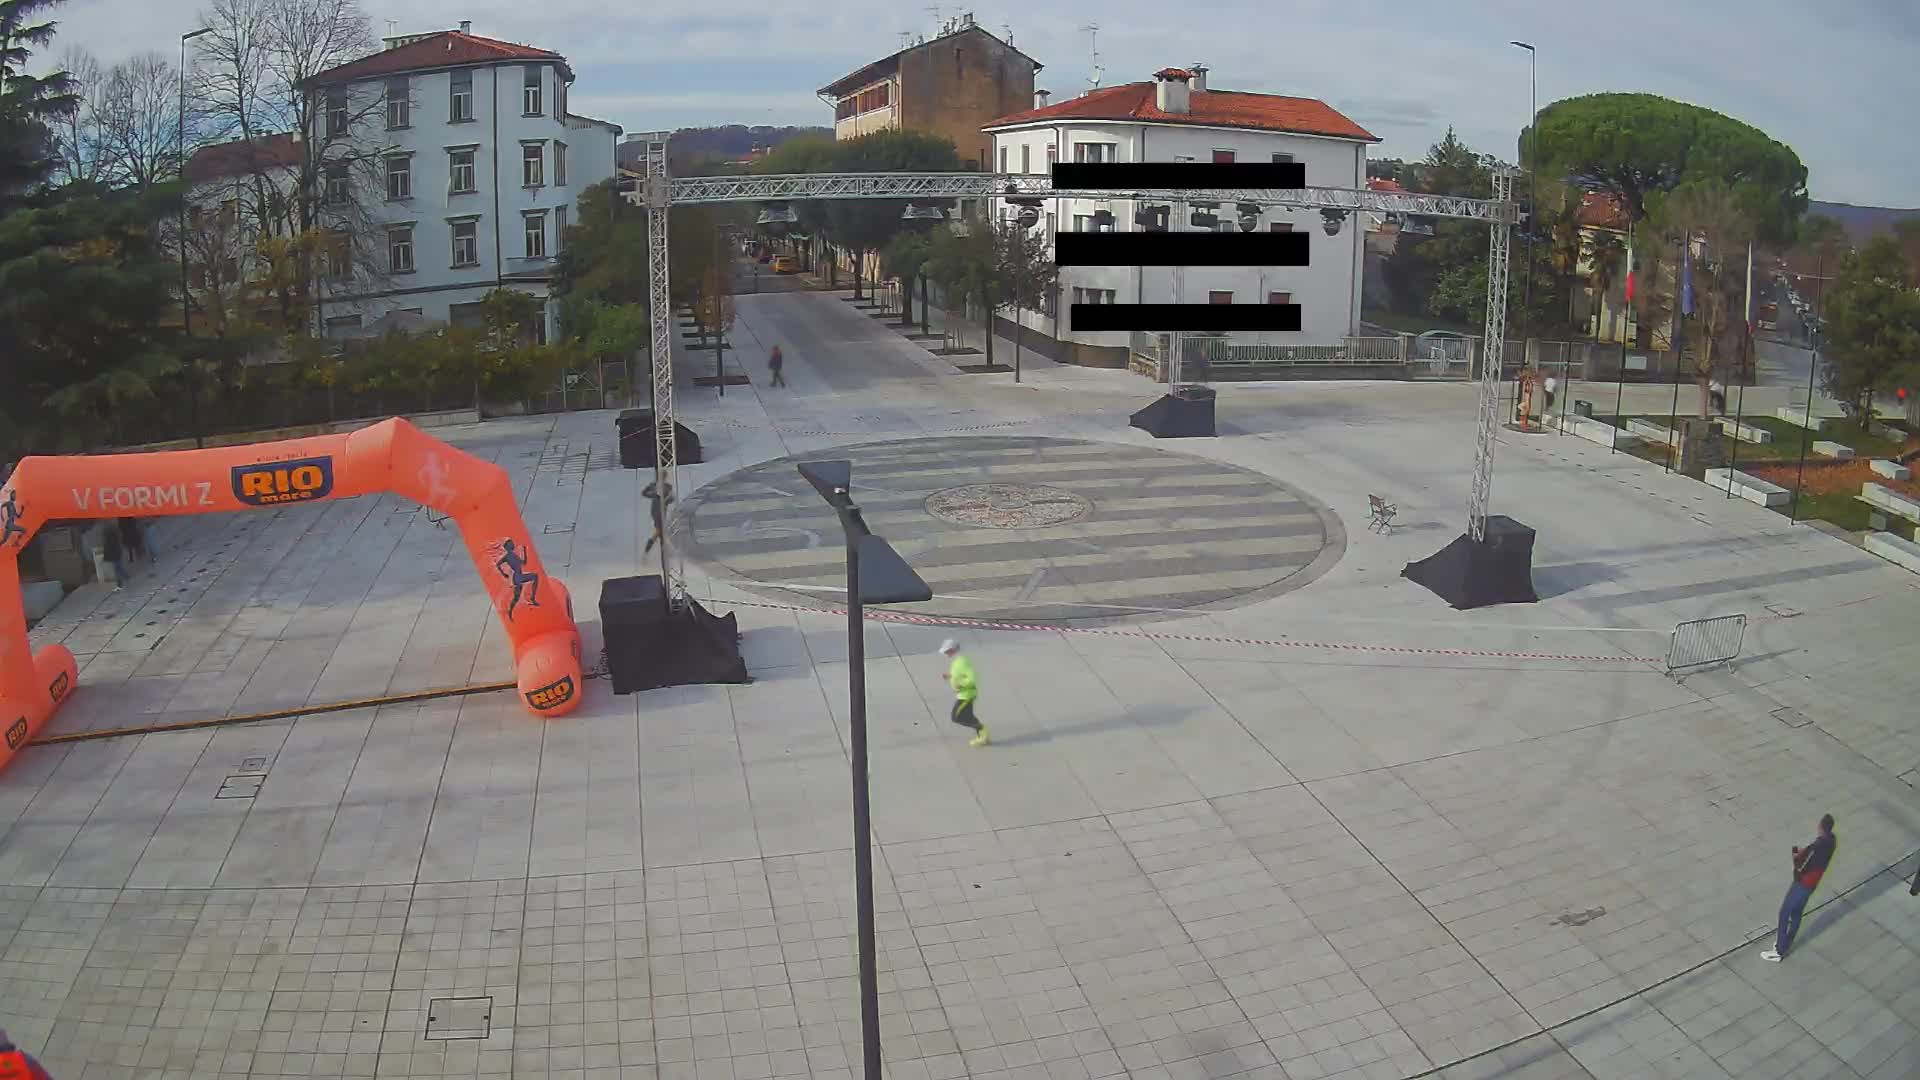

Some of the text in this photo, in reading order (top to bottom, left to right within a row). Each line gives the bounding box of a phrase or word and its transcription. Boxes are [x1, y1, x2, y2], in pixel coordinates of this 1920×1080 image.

[241, 465, 323, 497] RIO
[71, 487, 92, 511] V
[98, 483, 189, 510] FORMI
[531, 682, 570, 704] RIO
